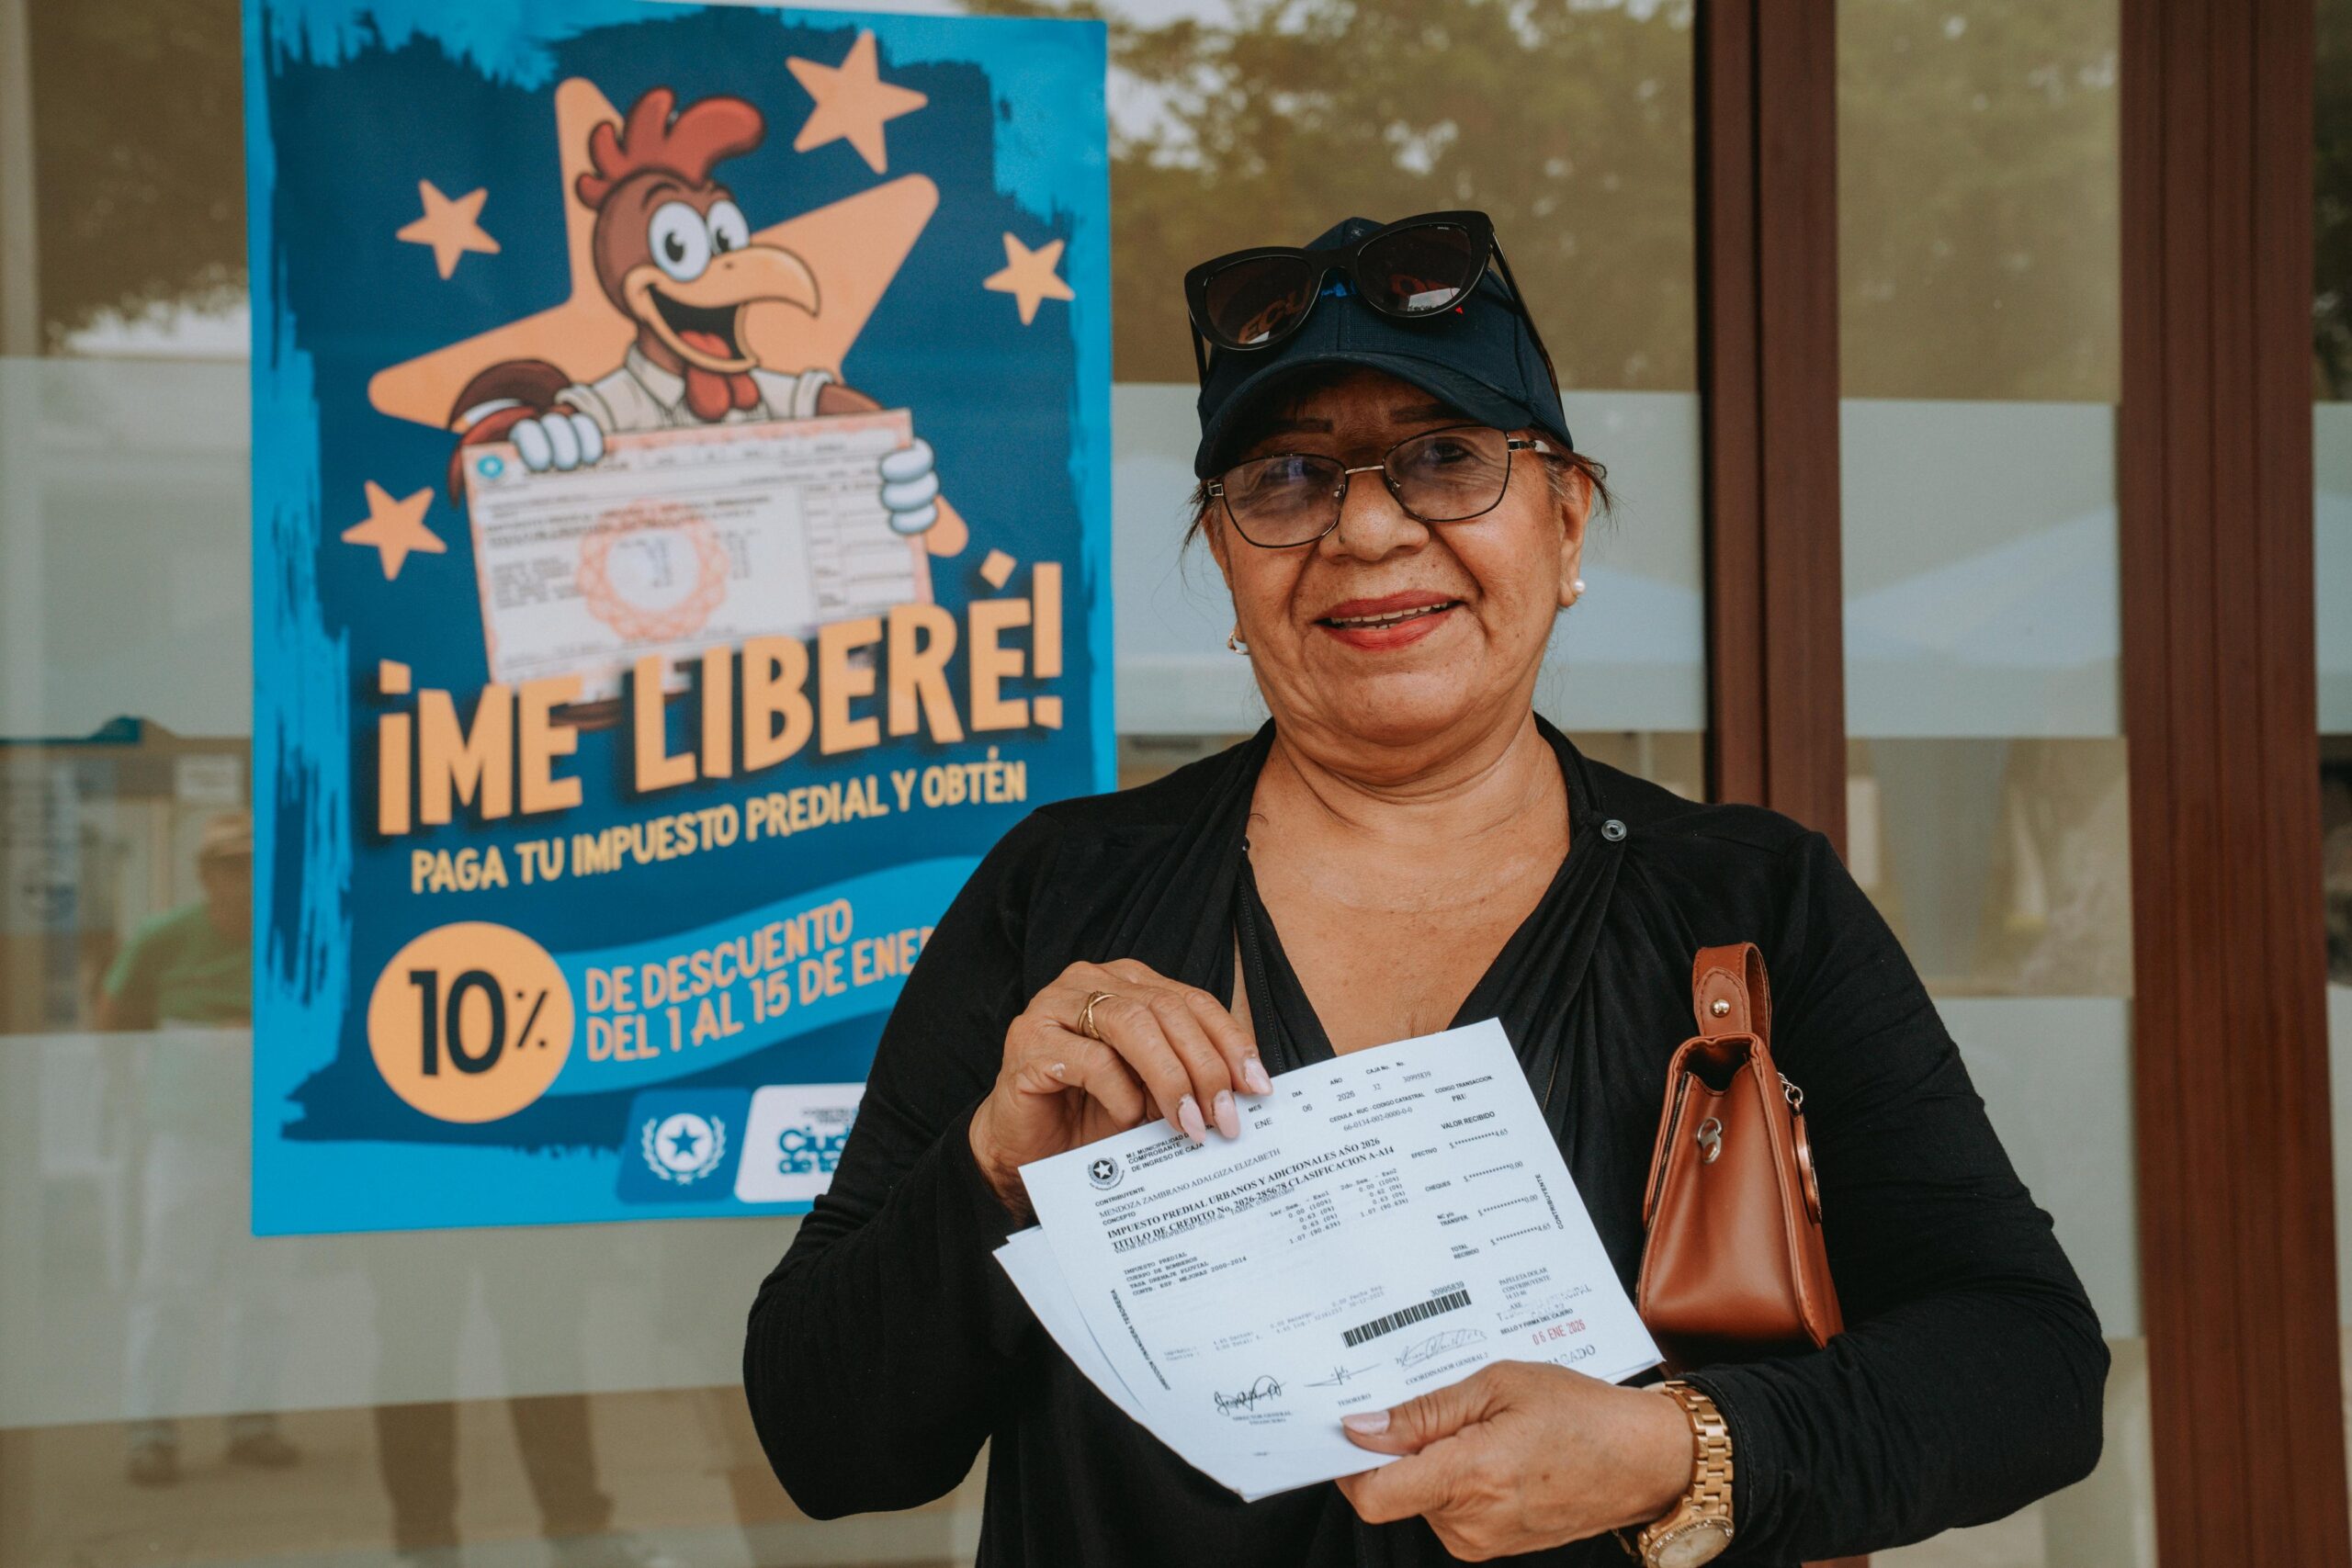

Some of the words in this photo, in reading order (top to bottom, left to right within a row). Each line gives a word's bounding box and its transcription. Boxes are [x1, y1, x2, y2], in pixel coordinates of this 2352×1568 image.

[379, 660, 582, 835] ¡ME
[633, 550, 1063, 794] LIBERÉ!
[412, 846, 508, 895] PAGA
[515, 842, 565, 885] TU
[573, 806, 736, 876] IMPUESTO
[746, 783, 888, 842] PREDIAL
[890, 769, 916, 810] Y
[924, 748, 1025, 808] OBTÉN
[587, 964, 634, 1014] DE
[641, 898, 854, 1009] DESCUENTO
[587, 1013, 659, 1063] DEL
[667, 1006, 684, 1052] 1
[691, 994, 744, 1046] AL
[752, 982, 788, 1023] 15
[798, 956, 843, 1007] DE
[853, 925, 937, 987] ENE
[408, 968, 548, 1077] 10%
[1330, 1077, 1343, 1086] AÑO
[1403, 1071, 1431, 1082] 30995839
[1337, 1090, 1355, 1101] 2026
[1373, 1083, 1382, 1091] 32
[1435, 1085, 1455, 1093] CODIGO
[1249, 1104, 1261, 1112] MES
[1303, 1104, 1312, 1112] 06
[1329, 1111, 1352, 1122] CEDULA
[1373, 1100, 1395, 1110] CODIGO
[1395, 1093, 1425, 1103] CATASTRAL
[1254, 1118, 1272, 1129] ENE
[1441, 1120, 1463, 1129] VALOR
[1463, 1111, 1495, 1124] RECIBIDO
[1128, 1141, 1182, 1164] COMPROBANTE
[1137, 1133, 1184, 1155] MUNICIPALIDAD
[1411, 1147, 1437, 1158] EFECTIVO
[1142, 1154, 1172, 1168] INGRESO
[1174, 1148, 1183, 1156] DE
[1185, 1143, 1204, 1152] CAJA
[1100, 1201, 1141, 1218] MENDOZA
[1143, 1183, 1190, 1204] ZAMBRANO
[1193, 1168, 1233, 1187] ADALGIZA
[1235, 1148, 1281, 1171] ELIZABETH
[1108, 1216, 1160, 1238] IMPUESTO
[1163, 1201, 1207, 1220] PREDIAL
[1209, 1181, 1257, 1204] URBANOS
[1269, 1153, 1336, 1182] ADICIONALES
[1340, 1145, 1359, 1156] AÑO
[1361, 1139, 1380, 1149] 2026
[1359, 1183, 1374, 1192] 0.00
[1425, 1181, 1451, 1191] CHEQUES
[1095, 1187, 1145, 1207] CONTRIBUYENTE
[1112, 1233, 1150, 1250] TITULO
[1153, 1227, 1167, 1236] DE
[1171, 1211, 1215, 1232] CREDITO
[1216, 1206, 1231, 1216] No.
[1235, 1182, 1288, 1209] 2026-285678
[1288, 1154, 1366, 1188] CLASIFICACION
[1370, 1146, 1394, 1159] A-A14
[1373, 1196, 1388, 1204] 0.63
[1535, 1174, 1564, 1229] CONTRIBUYENTE
[1102, 1212, 1136, 1225] CONCEPTO
[1288, 1208, 1305, 1218] 0.00
[1299, 1213, 1316, 1223] 0.63
[1360, 1207, 1375, 1217] 1.07
[1302, 1220, 1319, 1230] 0.63
[1114, 1242, 1136, 1253] VALOR
[1155, 1224, 1194, 1242] PROPIEDAD
[1290, 1234, 1305, 1244] 1.07
[1451, 1244, 1468, 1253] TOTAL
[1453, 1248, 1479, 1258] RECIBIDO
[1125, 1262, 1155, 1275] IMPUESTO
[1159, 1252, 1187, 1264] PREDIAL
[1126, 1271, 1150, 1281] CUERPO
[1165, 1257, 1197, 1270] BOMBEROS
[1179, 1269, 1207, 1282] MEJORAS
[1211, 1257, 1247, 1272] 2000-2014
[1130, 1280, 1146, 1289] TASA
[1148, 1271, 1177, 1283] DRENAJE
[1181, 1261, 1209, 1274] PLUVIAL
[1499, 1273, 1527, 1285] PAPELETA
[1527, 1268, 1547, 1277] DOLAR
[1502, 1275, 1551, 1293] CONTRIBUYENTE
[1551, 1308, 1573, 1319] CAJERO
[1547, 1325, 1566, 1340] ENE
[1566, 1319, 1586, 1334] 2026
[1406, 1363, 1455, 1385] COORDINADOR
[1455, 1354, 1483, 1367] GENERAL
[1338, 1393, 1371, 1406] TESORERO
